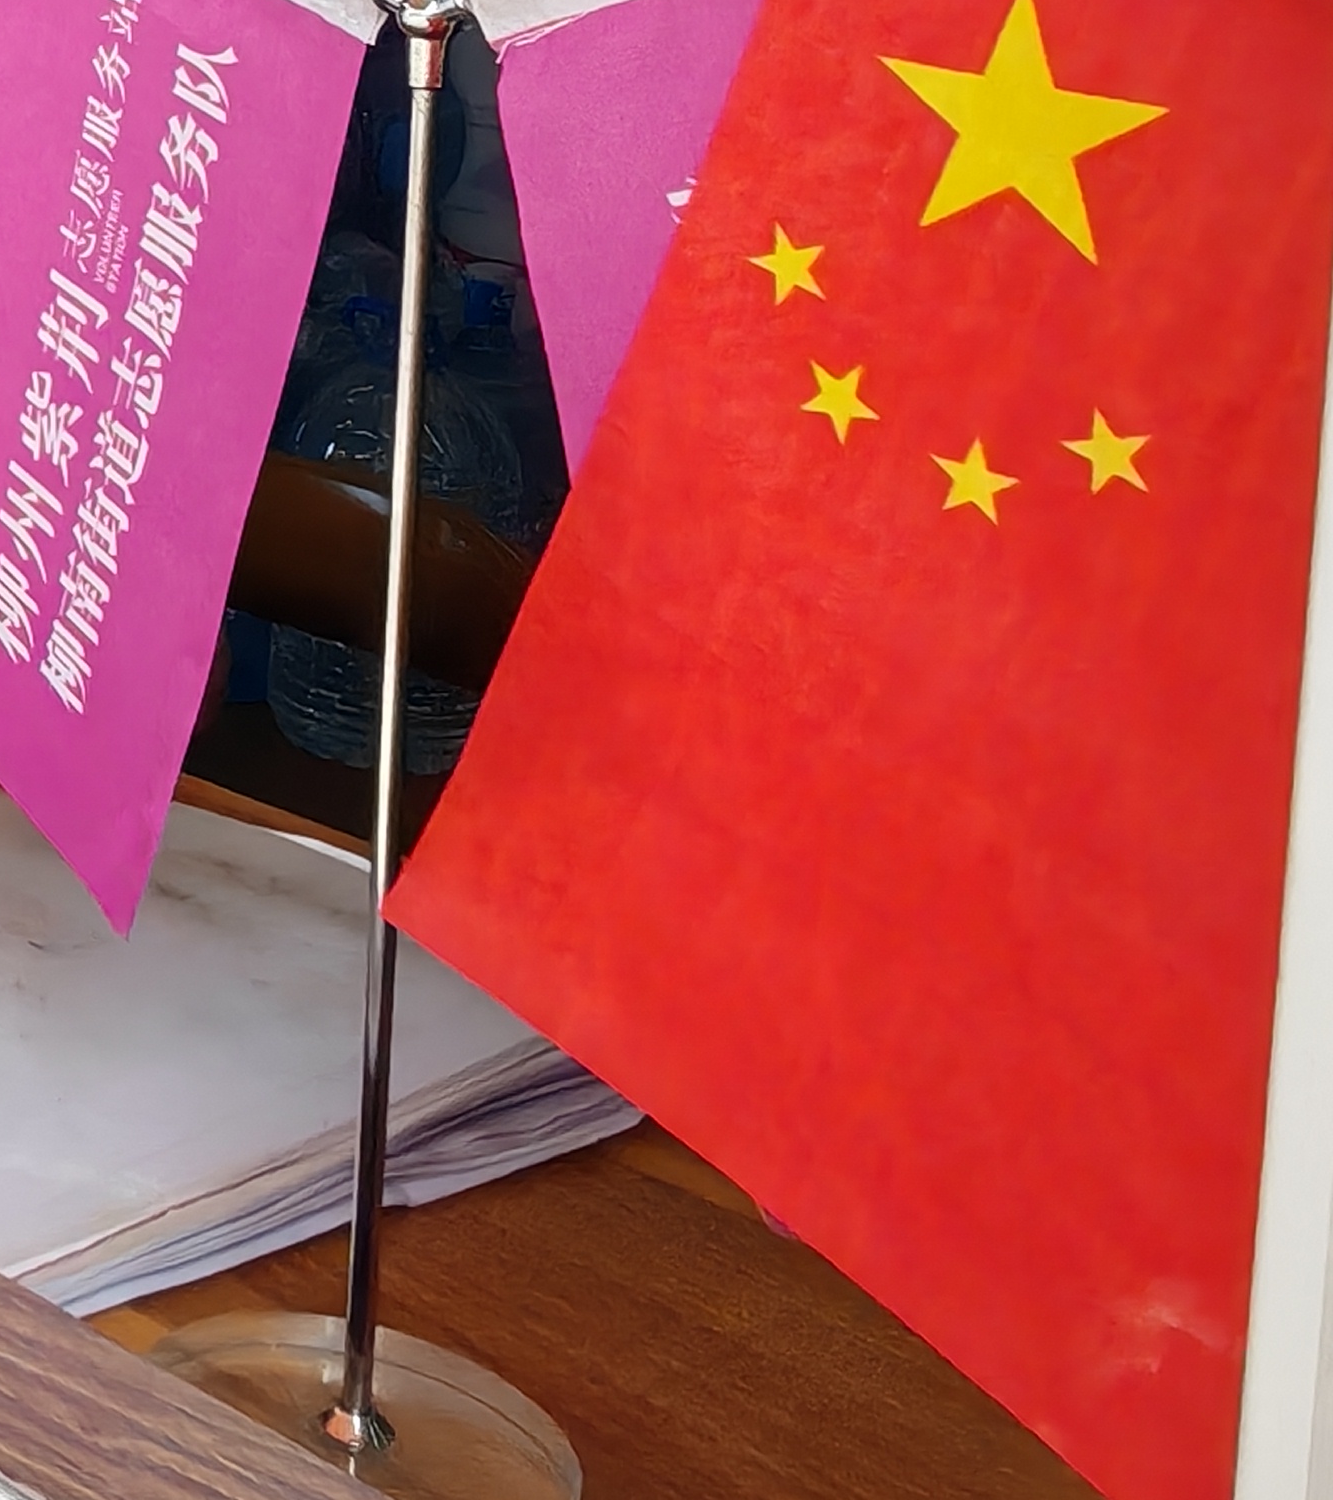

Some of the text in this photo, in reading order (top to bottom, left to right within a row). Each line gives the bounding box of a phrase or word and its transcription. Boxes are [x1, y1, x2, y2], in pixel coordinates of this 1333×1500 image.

[39, 41, 240, 715] 柳南街道志愿服务队
